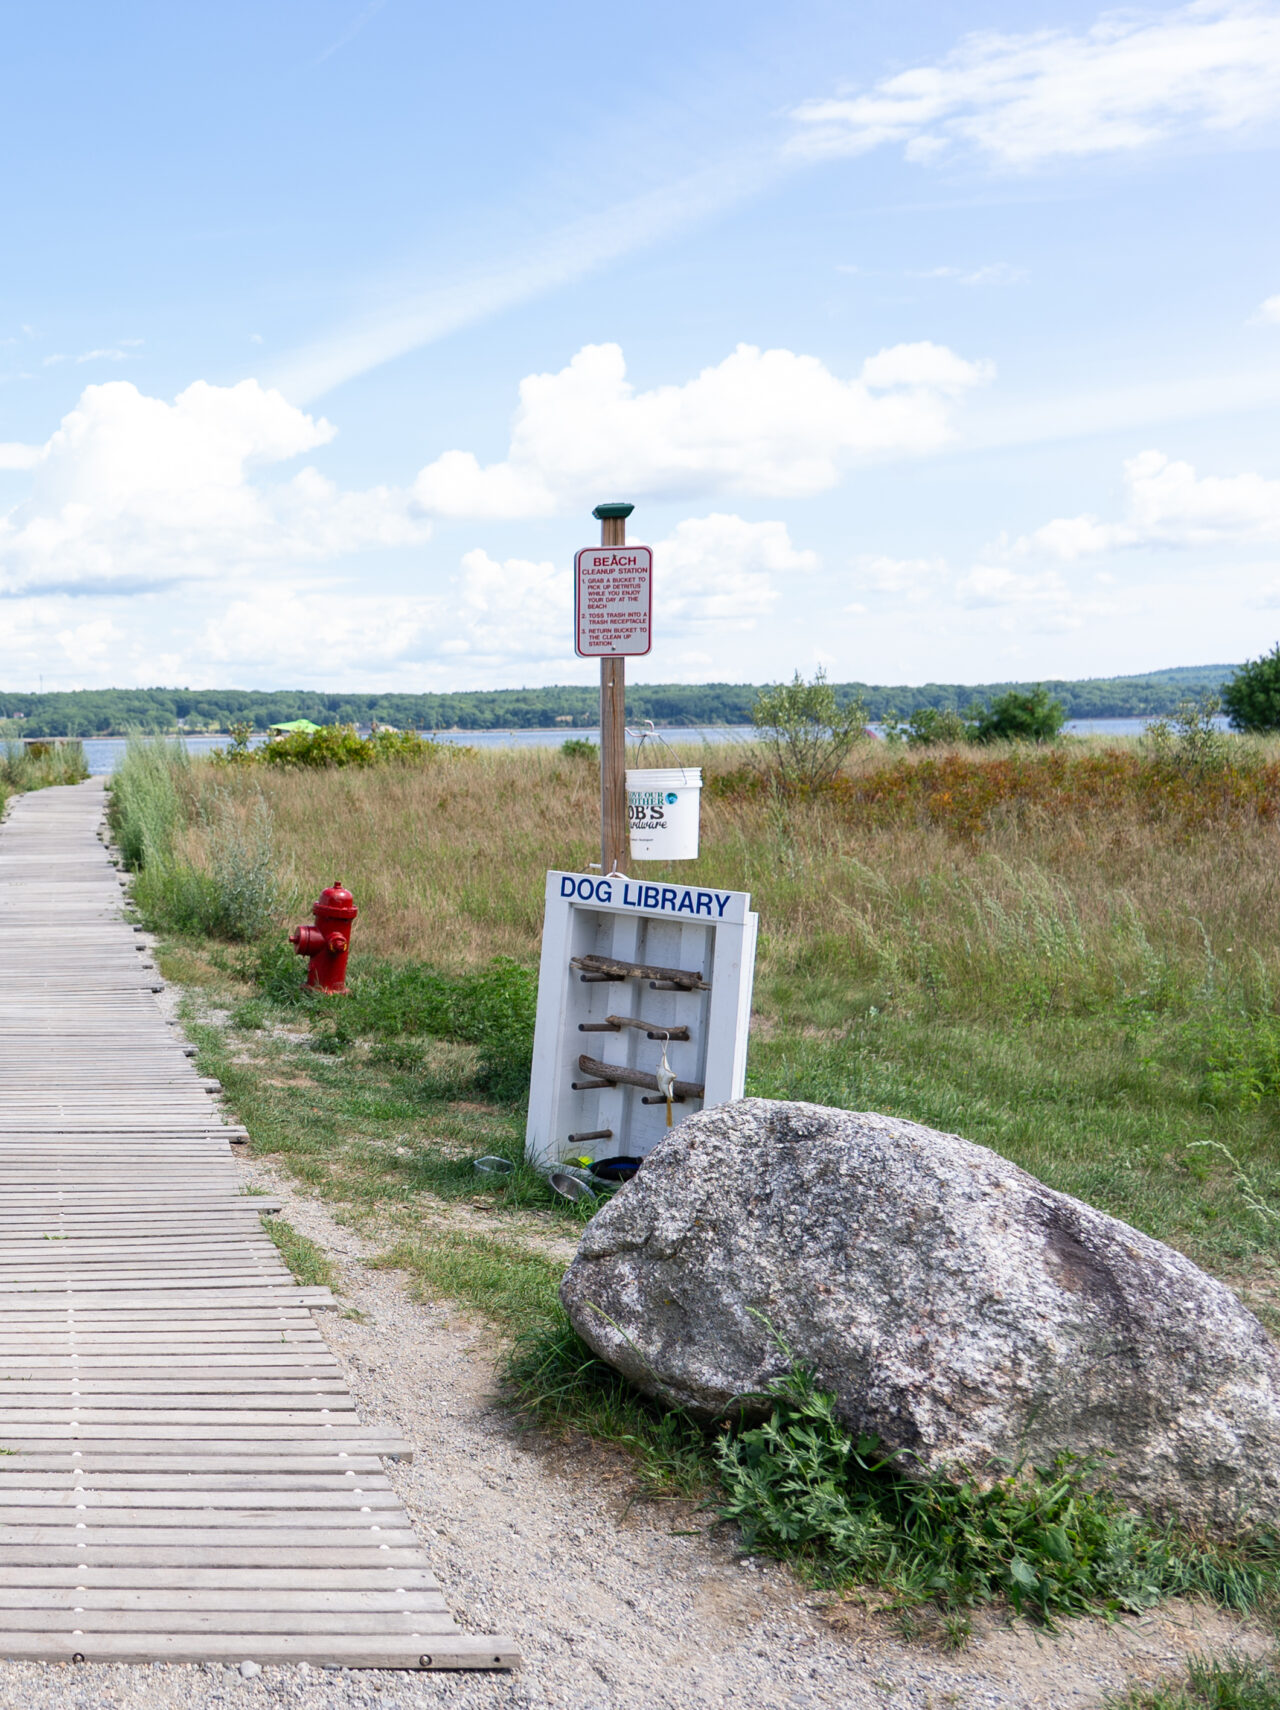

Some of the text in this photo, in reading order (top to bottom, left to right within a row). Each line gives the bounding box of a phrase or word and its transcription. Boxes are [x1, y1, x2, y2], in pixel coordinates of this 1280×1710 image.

[594, 556, 636, 566] BEACH
[560, 876, 731, 917] DOG LIBRARY
